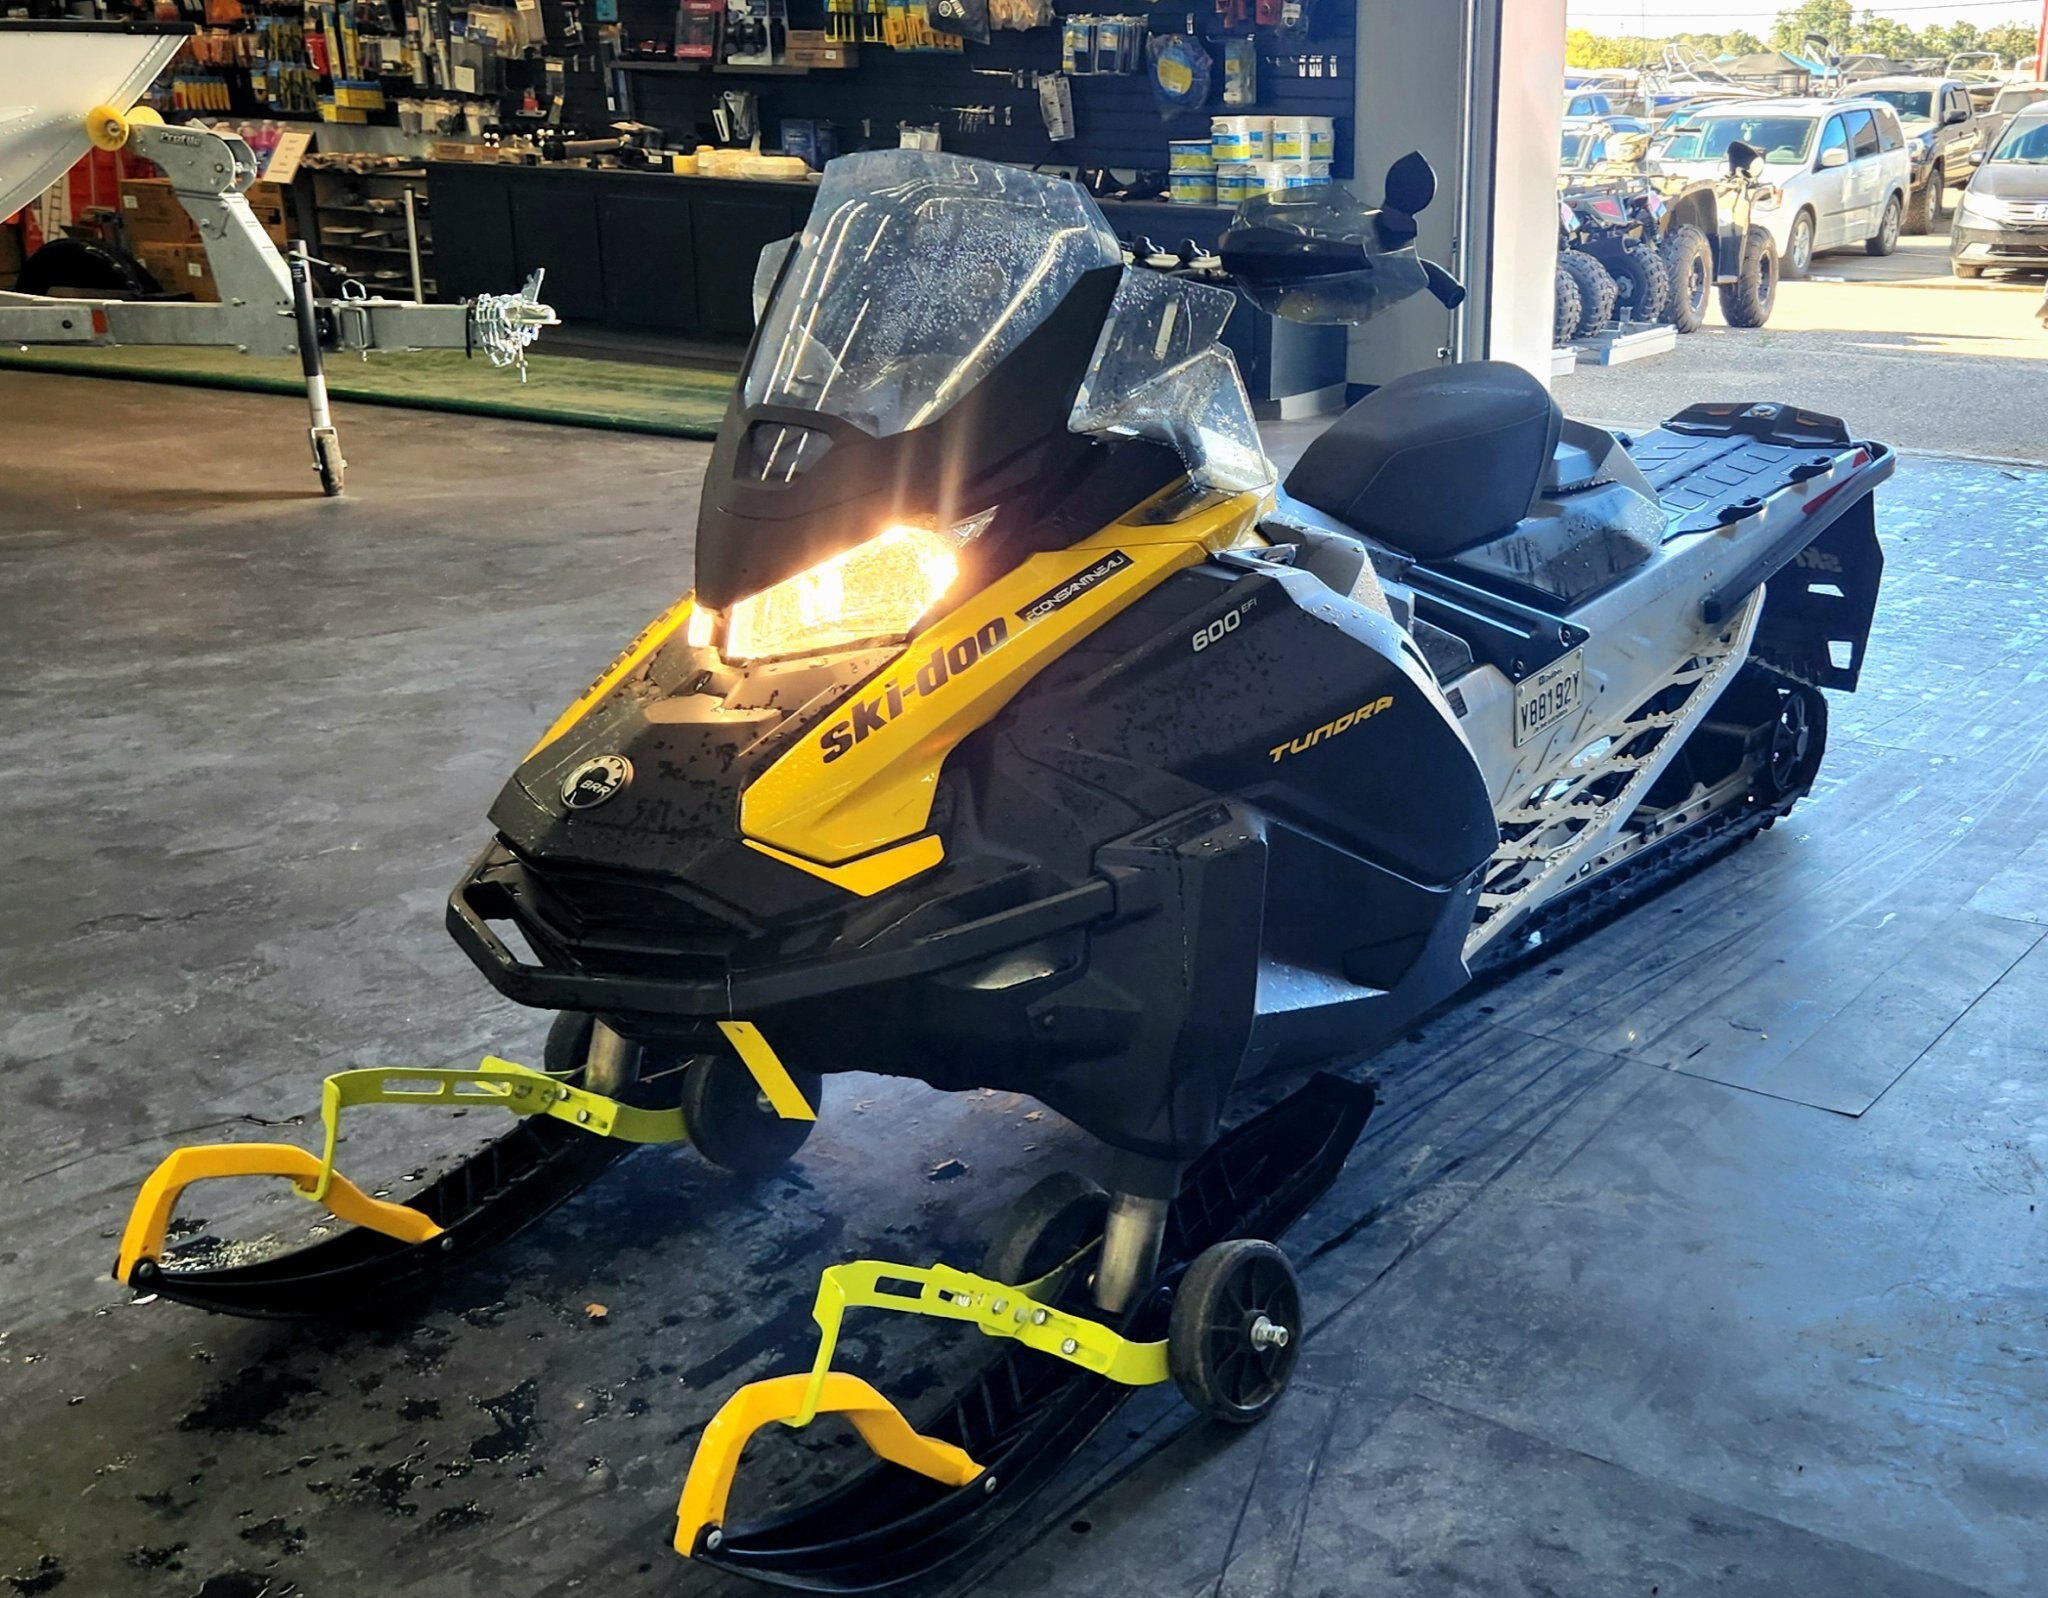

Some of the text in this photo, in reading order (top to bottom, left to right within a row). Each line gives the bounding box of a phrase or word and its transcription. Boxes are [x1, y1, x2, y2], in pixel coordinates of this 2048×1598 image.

[1191, 597, 1258, 653] 600 EFI
[819, 617, 1008, 764] ski-doo
[1268, 694, 1395, 764] TUNDRA
